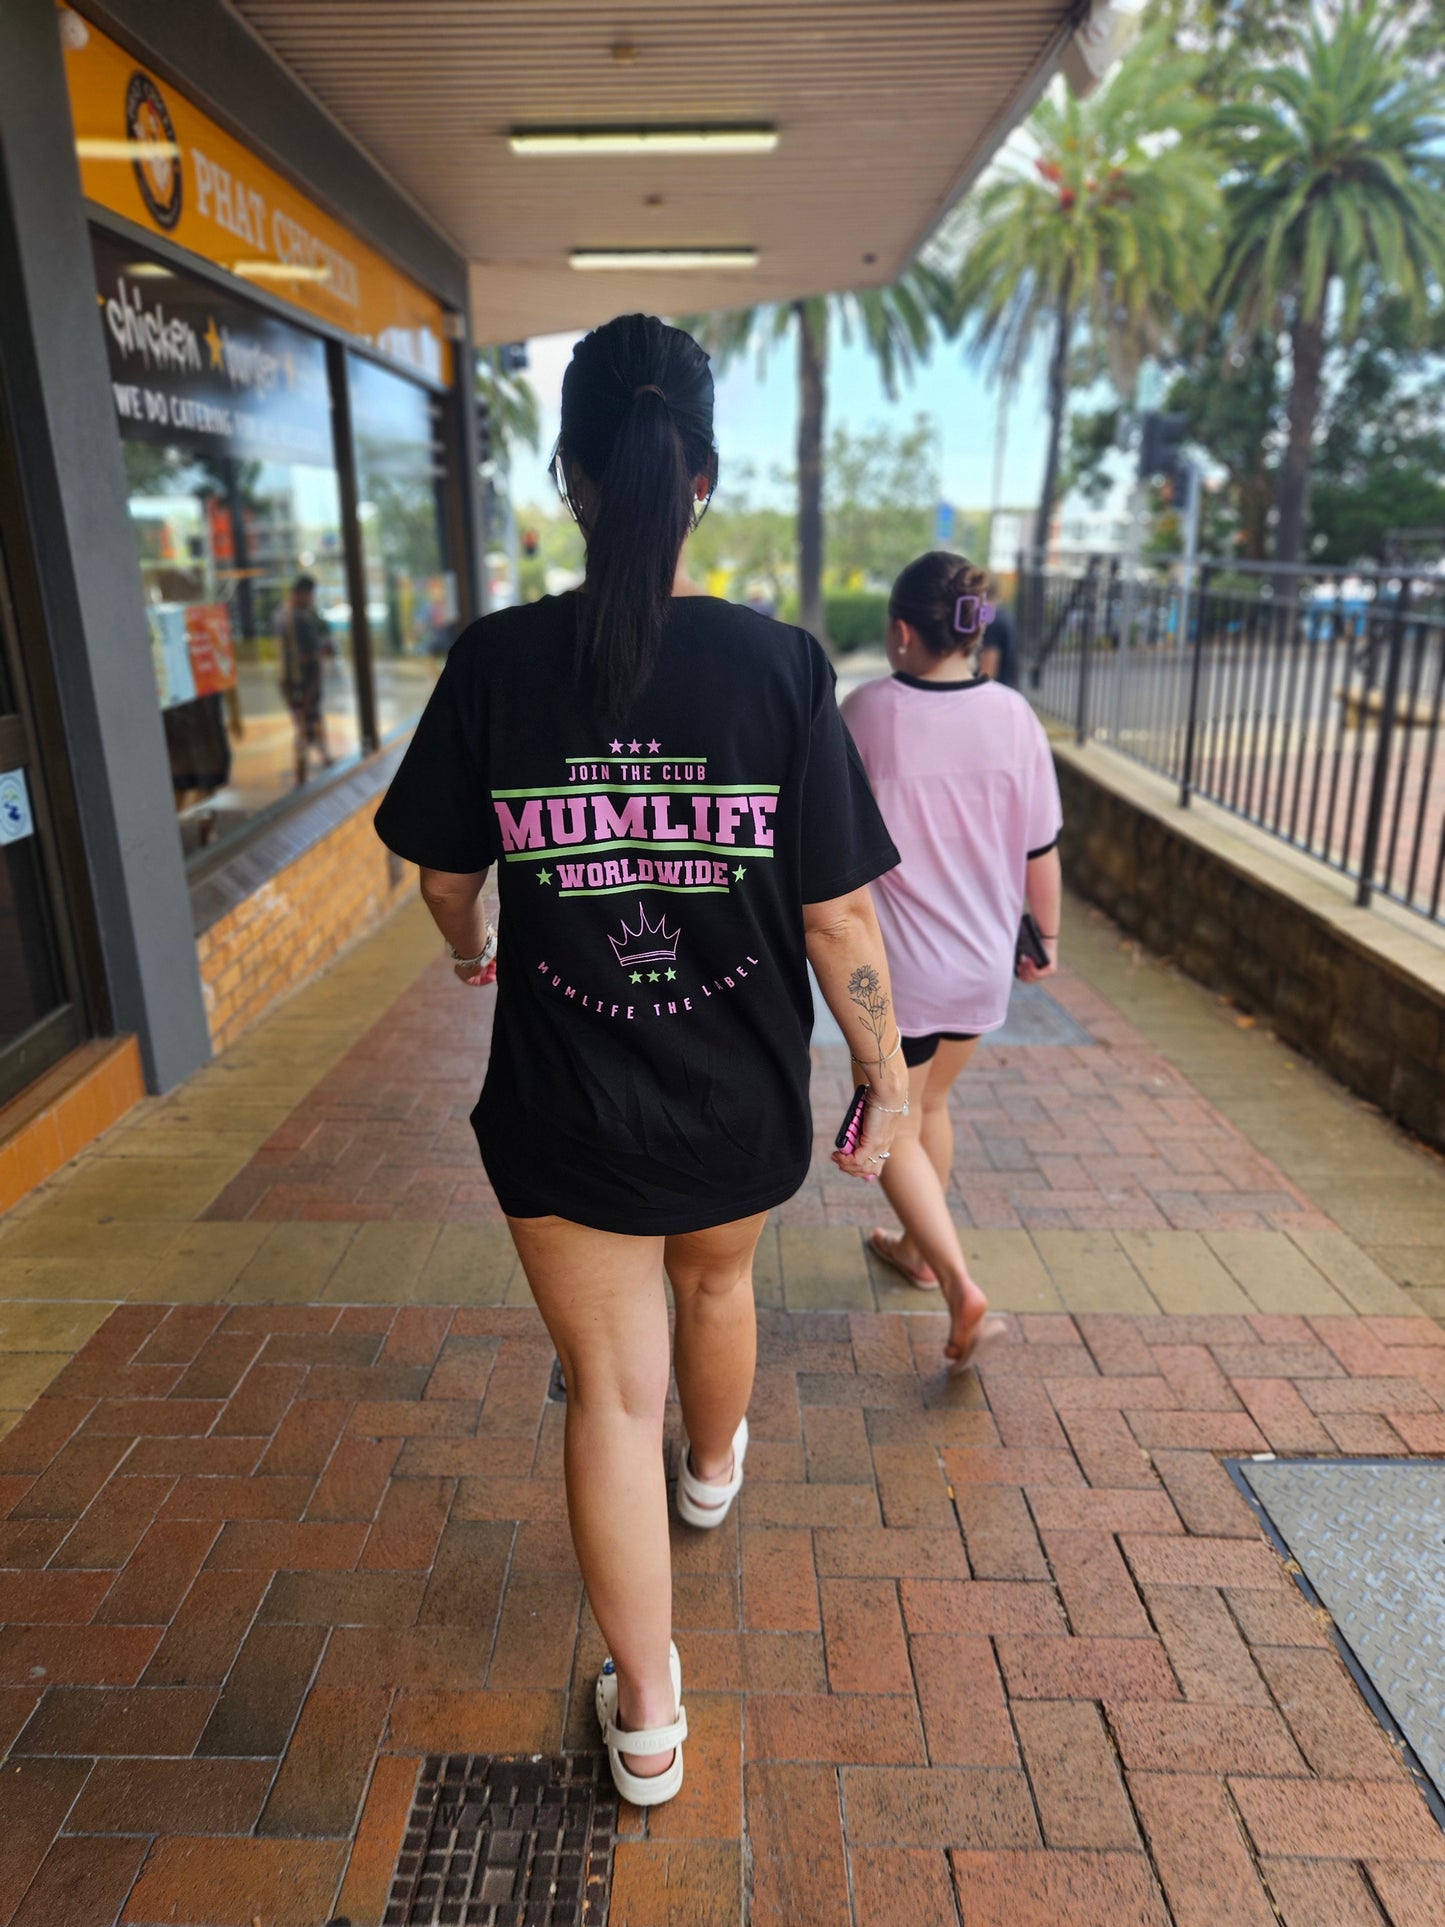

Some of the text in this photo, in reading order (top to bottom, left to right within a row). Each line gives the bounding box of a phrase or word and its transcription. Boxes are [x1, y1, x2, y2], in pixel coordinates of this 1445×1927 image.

[191, 147, 267, 252] PHAT
[106, 277, 202, 374] chicken
[112, 381, 143, 420] WE
[143, 387, 169, 426] DO
[568, 765, 707, 782] JOIN THE CLUB
[493, 795, 778, 852] MUMLIFE
[556, 858, 729, 888] WORLDWIDE
[537, 955, 759, 1019] MUMLIFE THE LABEL
